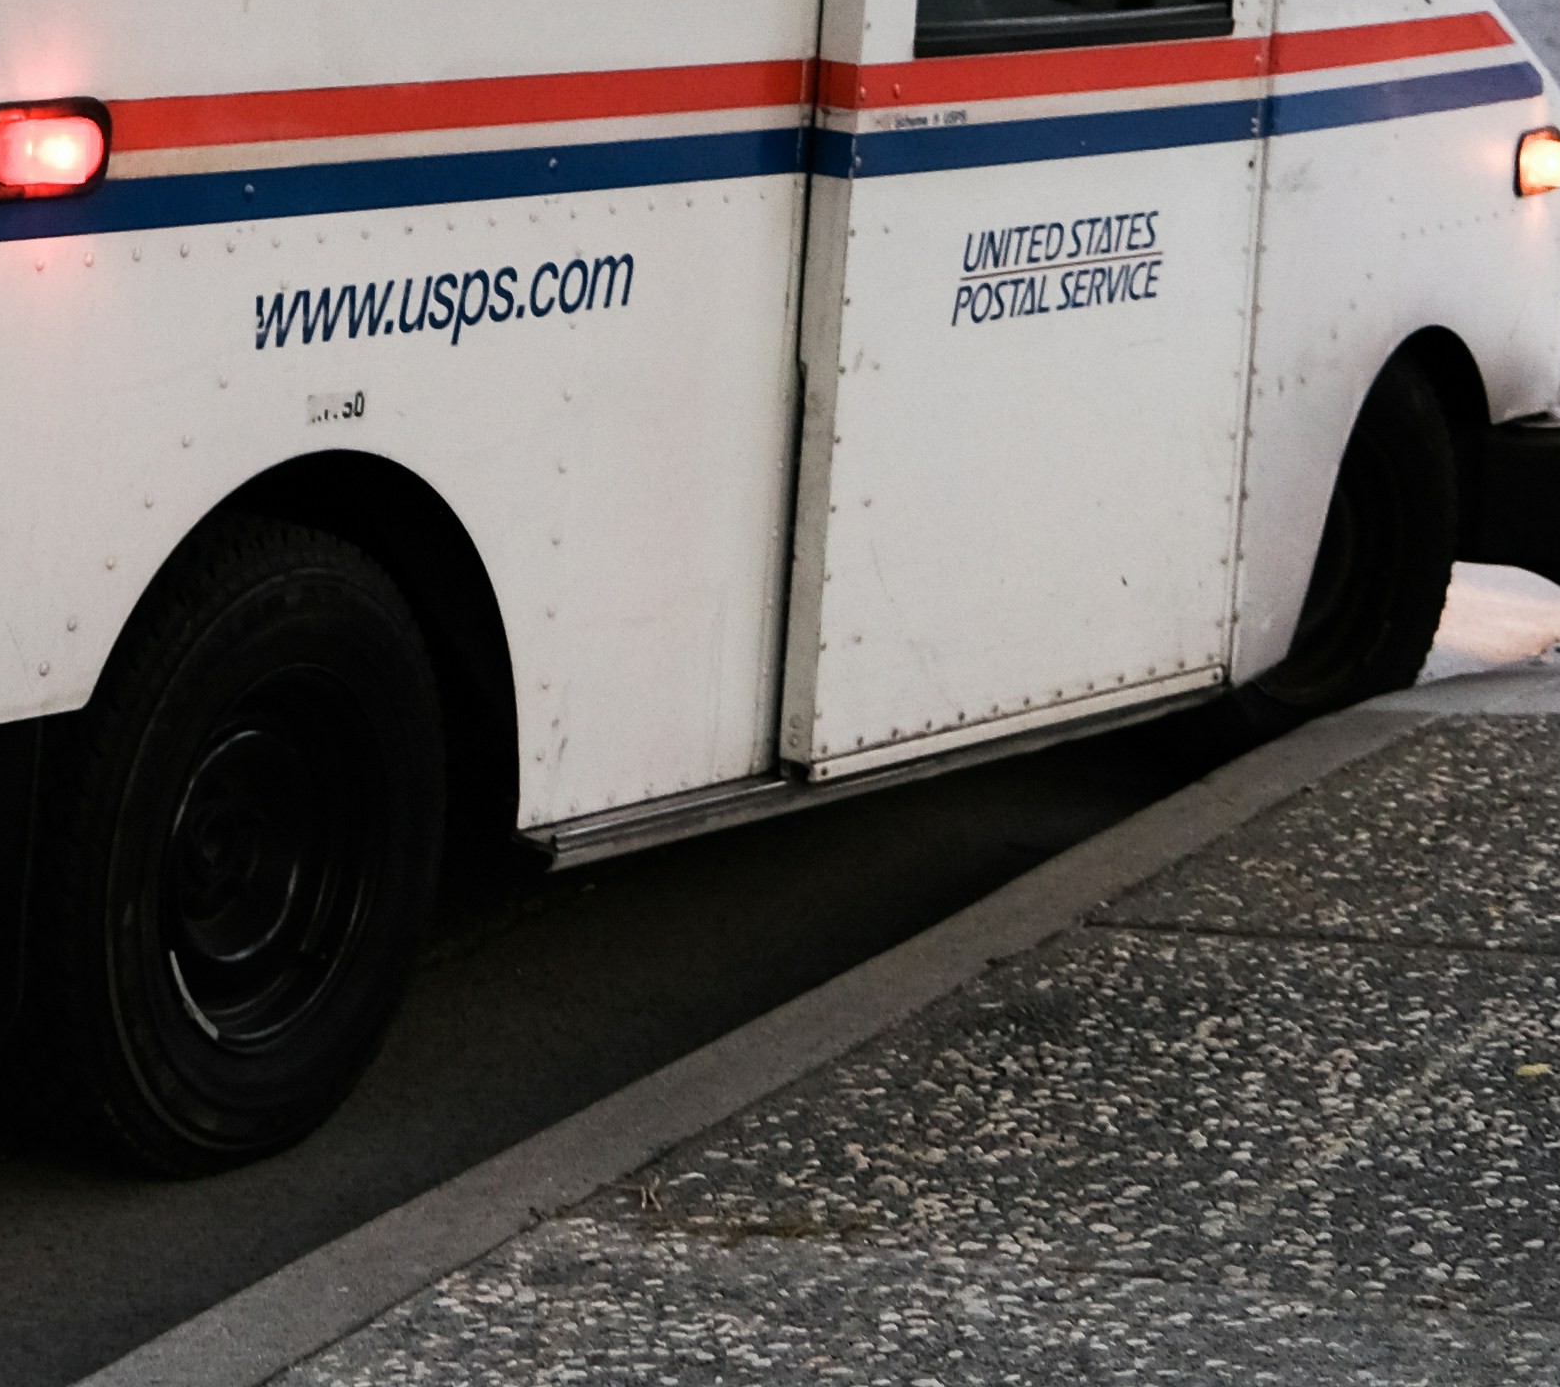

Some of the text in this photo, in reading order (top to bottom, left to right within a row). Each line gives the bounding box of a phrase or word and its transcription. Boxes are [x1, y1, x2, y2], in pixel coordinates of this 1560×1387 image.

[963, 211, 1159, 273] UNITED STATES
[255, 251, 634, 350] www.usps.com
[951, 260, 1163, 327] POSTAL SERVICE
